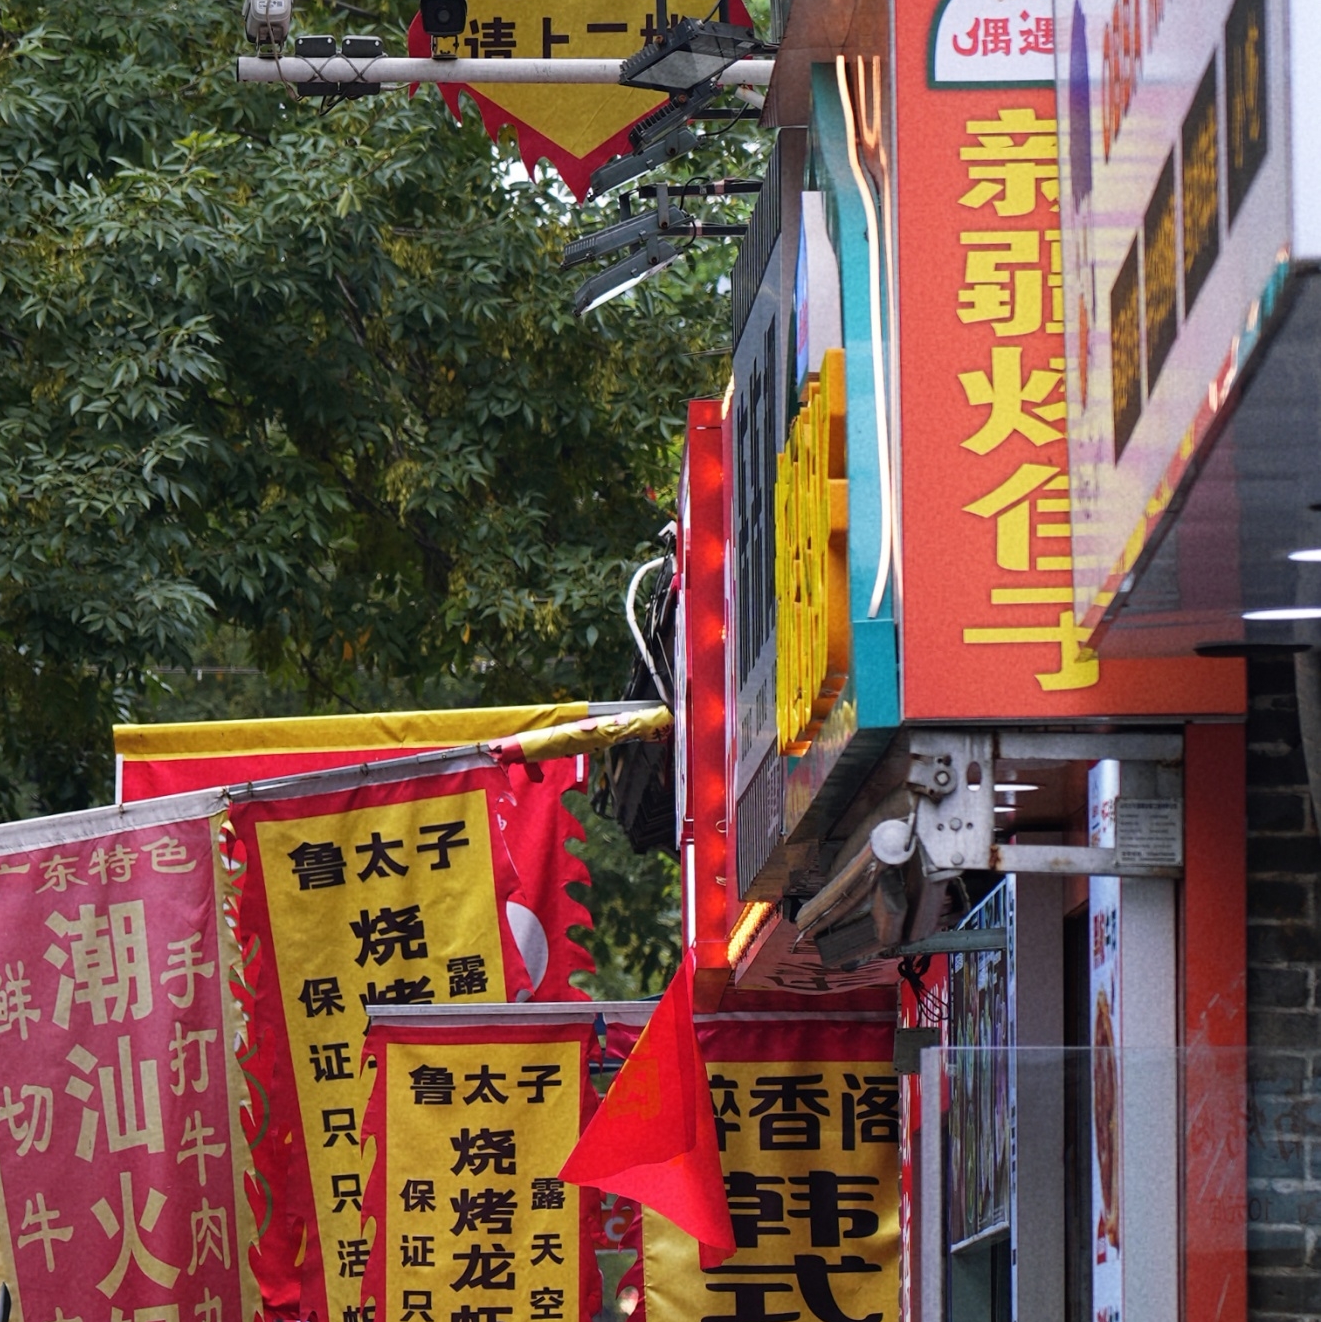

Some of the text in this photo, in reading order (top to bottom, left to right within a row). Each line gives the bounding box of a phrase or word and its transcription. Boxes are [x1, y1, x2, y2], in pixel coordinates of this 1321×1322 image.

[287, 820, 469, 890] 鲁太子
[408, 1062, 562, 1107] 鲁太子
